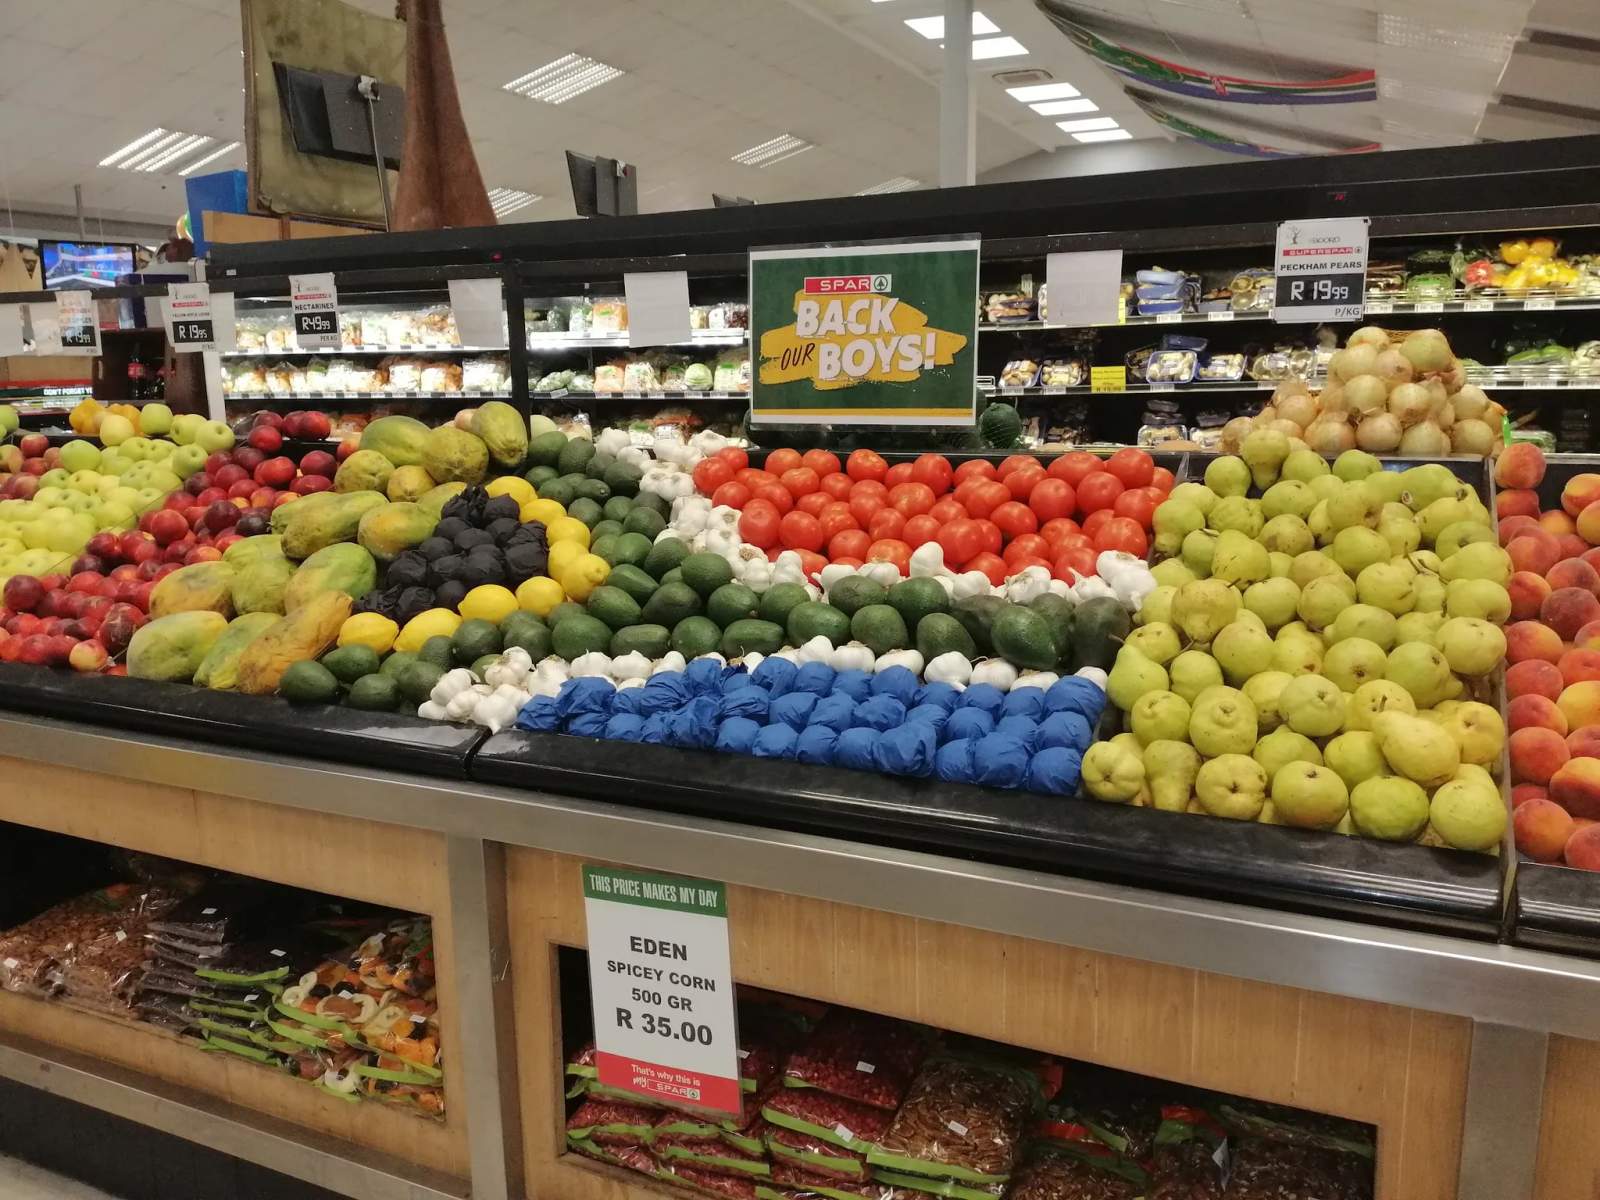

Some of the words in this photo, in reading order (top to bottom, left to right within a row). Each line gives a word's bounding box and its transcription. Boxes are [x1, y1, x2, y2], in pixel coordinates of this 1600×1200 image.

[1288, 247, 1353, 256] SUPERSPAR
[1280, 262, 1327, 271] PECKHAM
[1330, 261, 1362, 269] PEARS
[820, 278, 870, 291] SPAR
[1290, 281, 1304, 300] R
[795, 298, 899, 337] BACK
[1335, 306, 1360, 317] P/KG
[780, 342, 816, 371] OUR
[818, 332, 937, 381] BOYS!
[589, 874, 611, 893] THIS
[612, 878, 641, 898] PRICE
[642, 882, 678, 903] MAKES
[679, 886, 696, 905] MY
[698, 889, 718, 908] DAY
[630, 936, 688, 961] EDEN
[607, 960, 664, 982] SPICEY
[669, 972, 716, 992] CORN
[632, 988, 662, 1006] 500
[667, 995, 693, 1012] GR
[616, 1007, 633, 1030] R
[641, 1013, 713, 1046] 35.00
[631, 1063, 655, 1077] That's
[657, 1071, 673, 1082] why
[676, 1074, 691, 1085] this
[693, 1077, 700, 1087] is
[656, 1083, 688, 1097] SPAR
